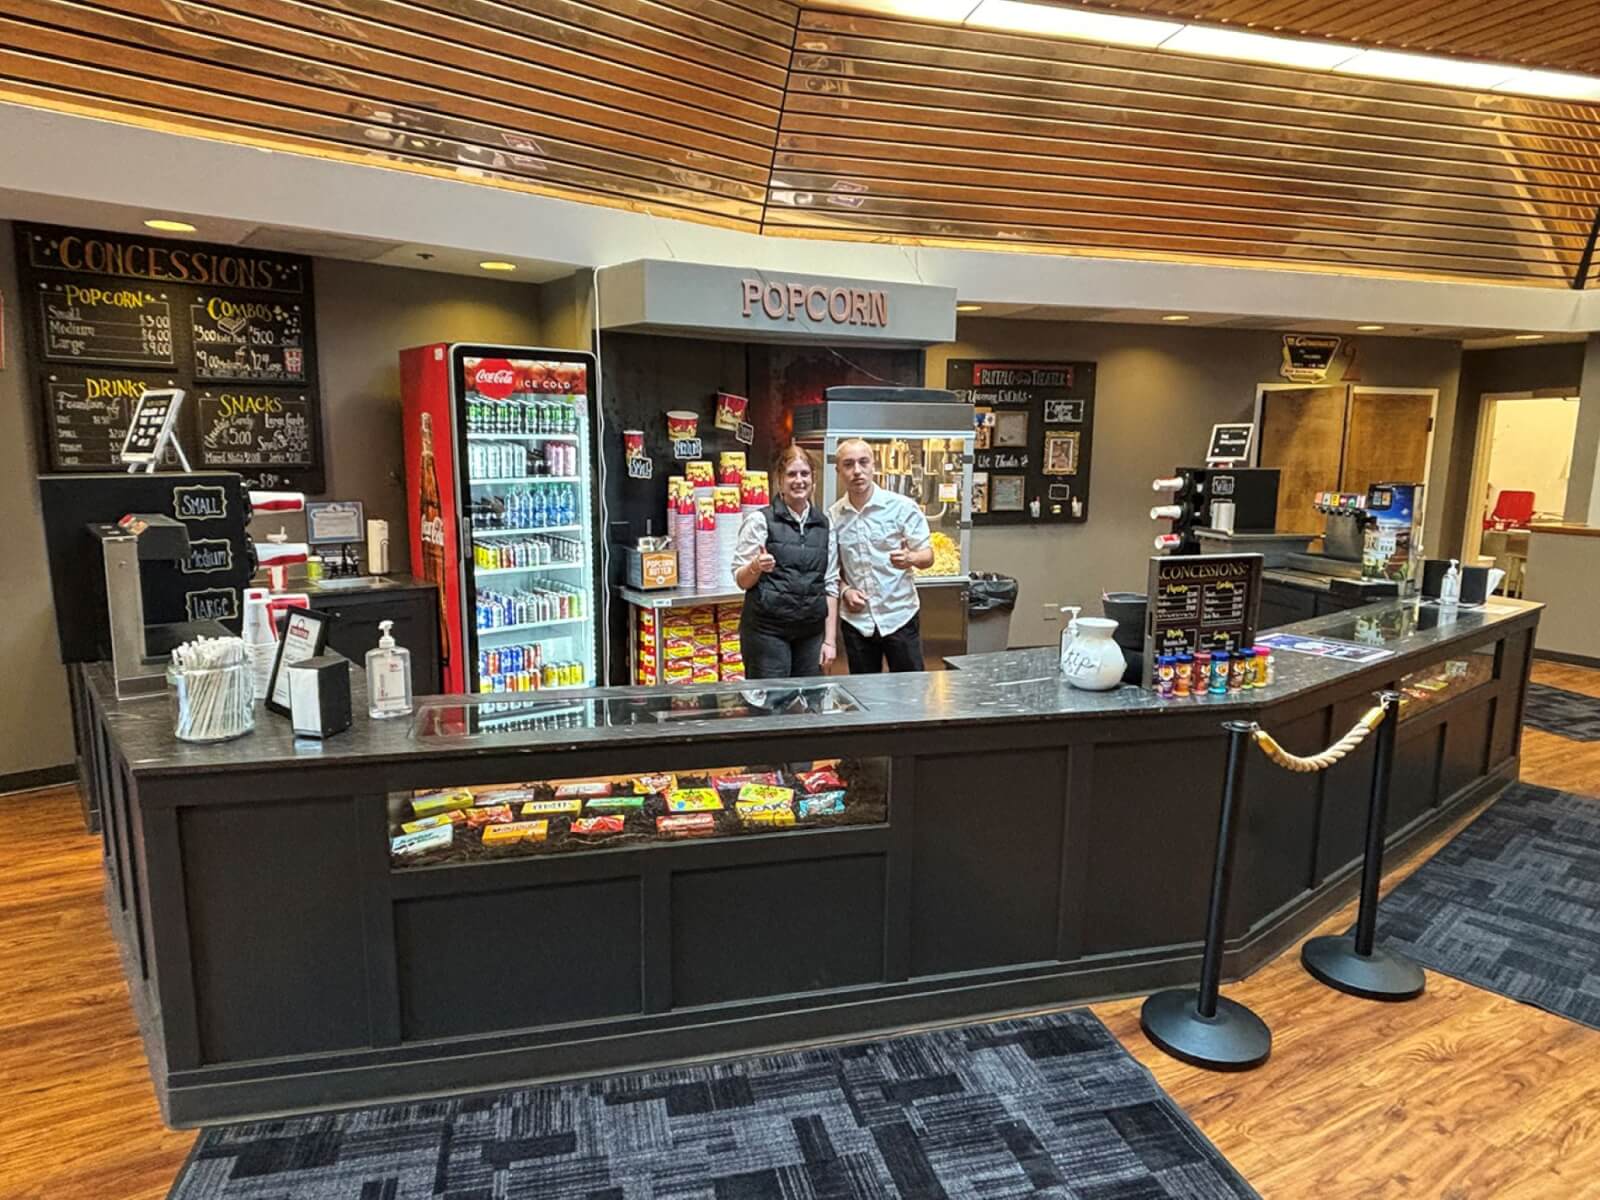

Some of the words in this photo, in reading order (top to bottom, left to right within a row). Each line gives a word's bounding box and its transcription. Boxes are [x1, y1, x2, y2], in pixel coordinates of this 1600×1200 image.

[58, 235, 273, 289] CONCESSIONS
[65, 284, 144, 309] POPCORN
[741, 278, 888, 327] POPCORN
[47, 304, 82, 321] Small
[207, 296, 273, 322] COMBOS
[51, 335, 86, 355] Large
[86, 377, 148, 399] DRINKS
[520, 379, 539, 390] ICE
[542, 380, 572, 391] COLD
[217, 393, 283, 418] SNACKS
[181, 494, 222, 515] SMALL
[1161, 562, 1246, 580] CONCESSIONS
